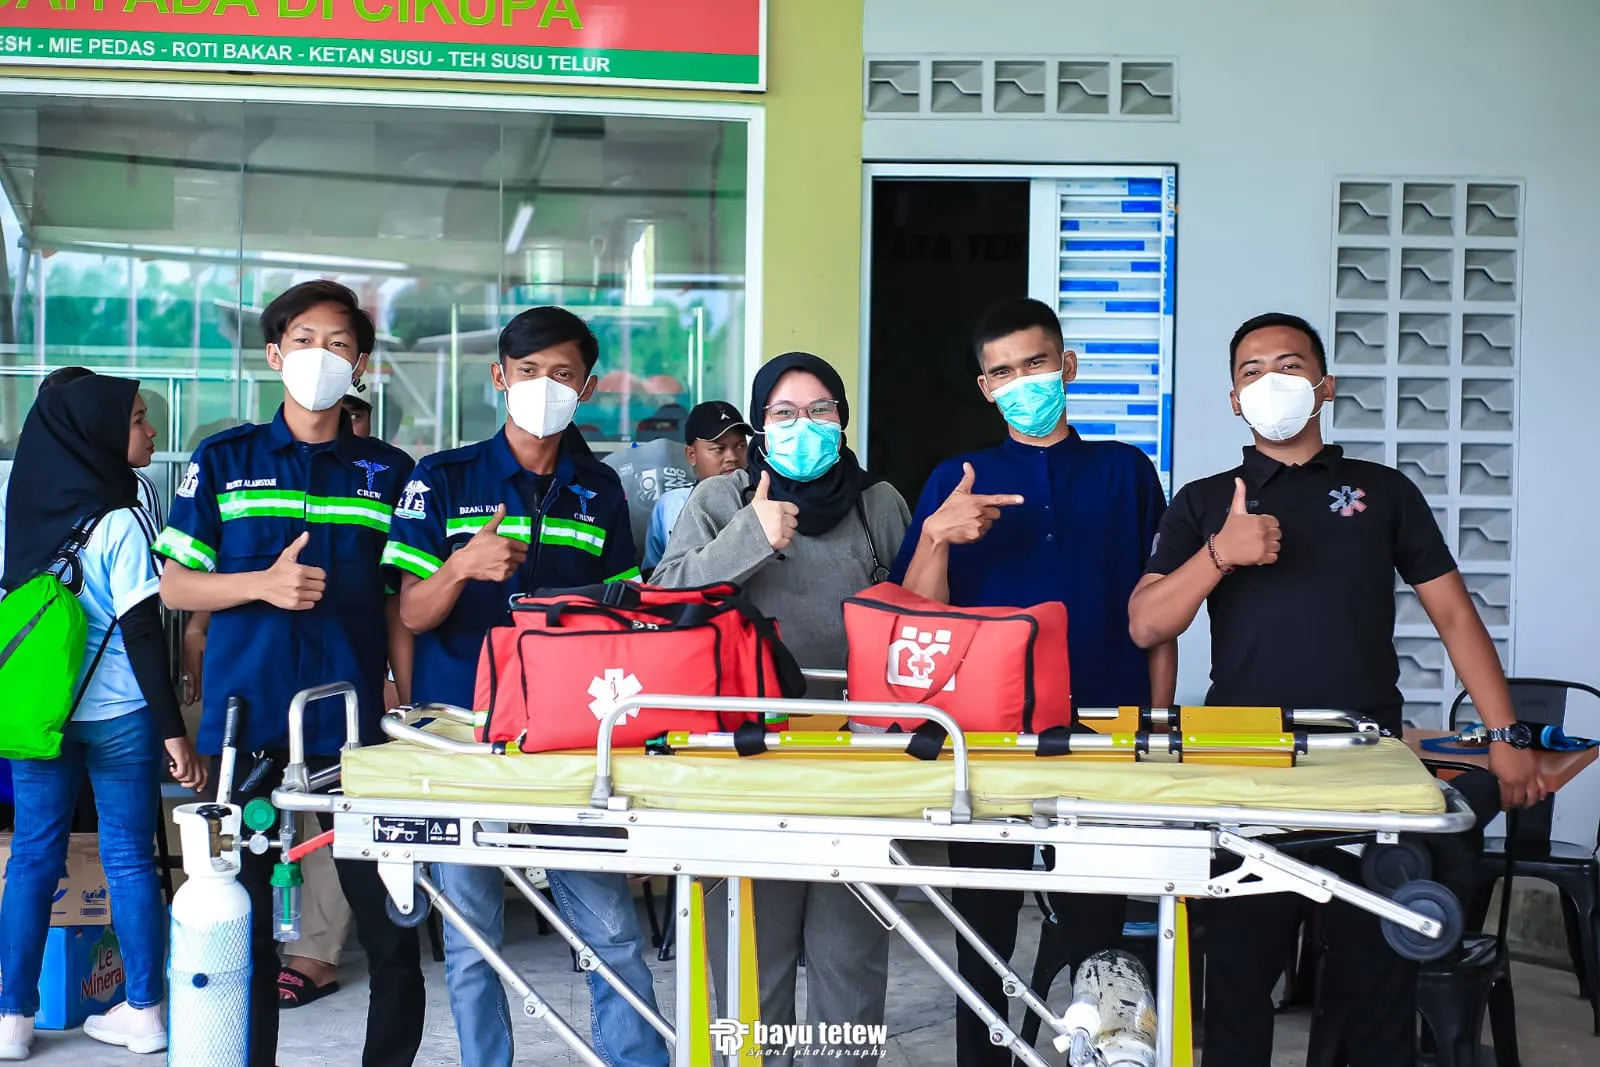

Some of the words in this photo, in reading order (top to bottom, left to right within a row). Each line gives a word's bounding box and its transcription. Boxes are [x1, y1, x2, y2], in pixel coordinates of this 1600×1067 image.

[49, 37, 83, 54] MIE
[88, 38, 155, 56] PEDAS
[172, 41, 217, 58] ROTI
[223, 43, 292, 61] BAKAR
[309, 46, 374, 64] KETAN
[380, 48, 432, 66] SUSU
[448, 51, 486, 68] TEH
[491, 53, 543, 70] SUSU
[548, 55, 610, 73] TELUR
[356, 488, 382, 500] CREW
[574, 512, 595, 523] CREW
[98, 945, 113, 972] Le
